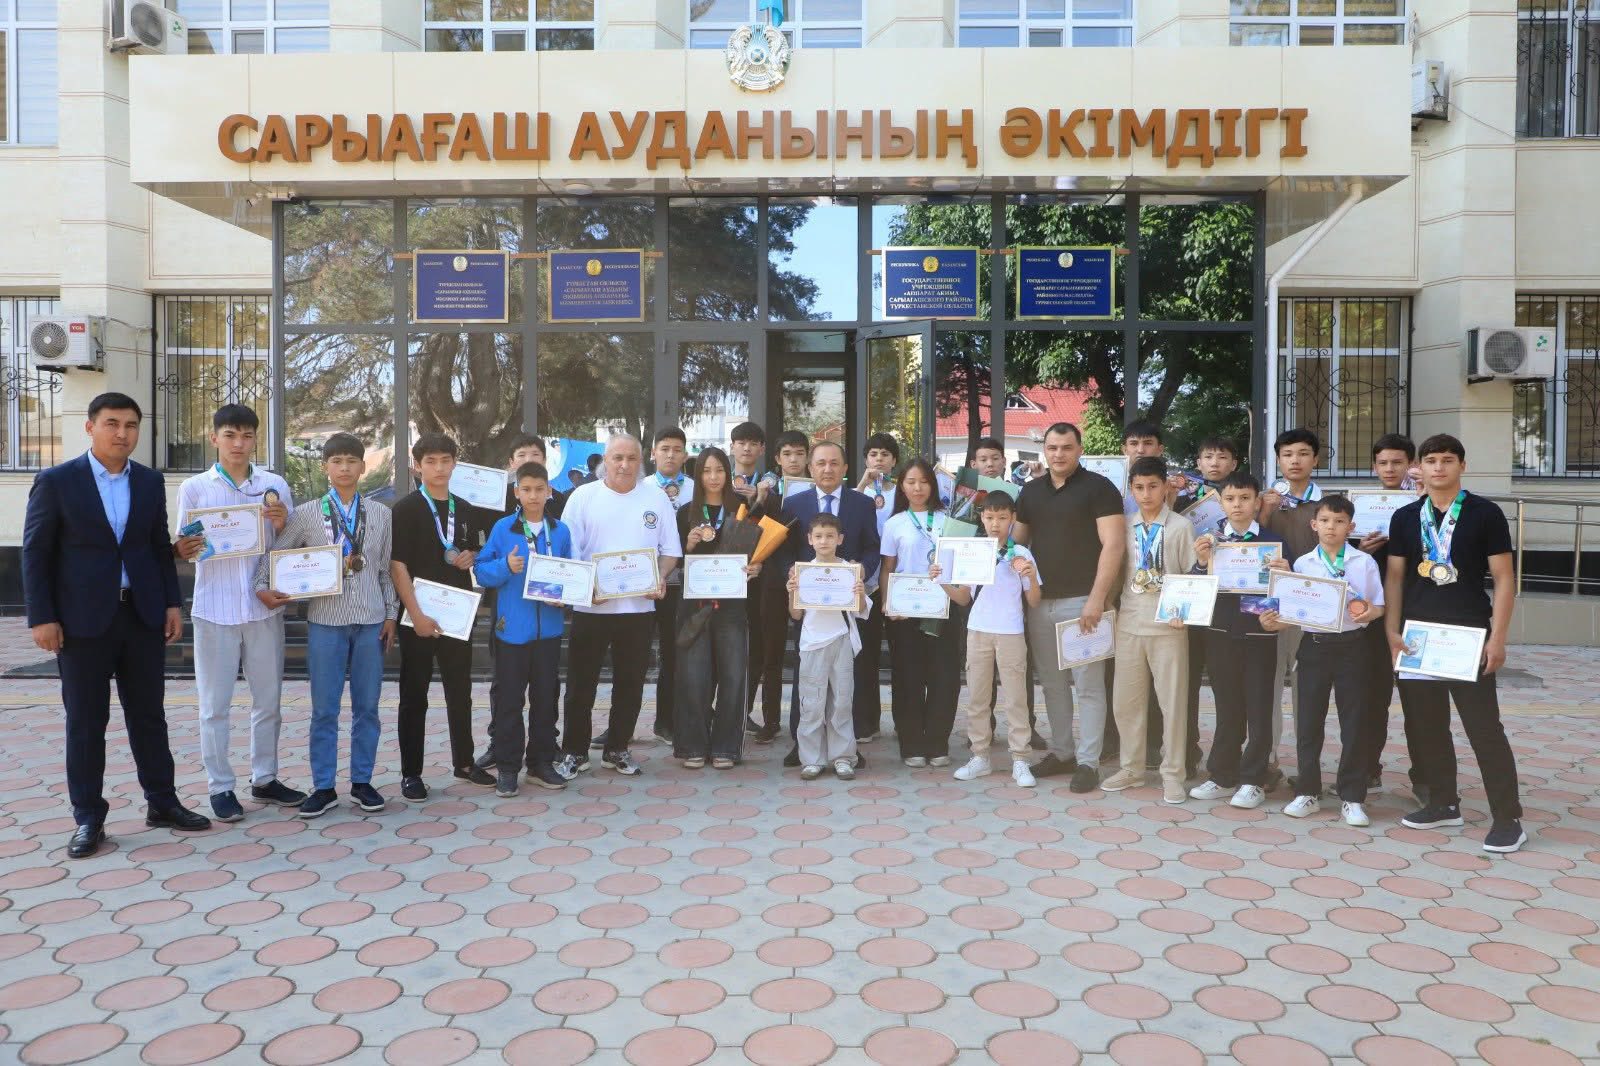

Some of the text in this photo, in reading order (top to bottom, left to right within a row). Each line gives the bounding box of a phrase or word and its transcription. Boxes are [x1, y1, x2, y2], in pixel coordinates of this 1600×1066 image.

[217, 107, 1309, 170] САРЫАҒАШ АУДАНЫНЫҢ ӘКІМДІГІ
